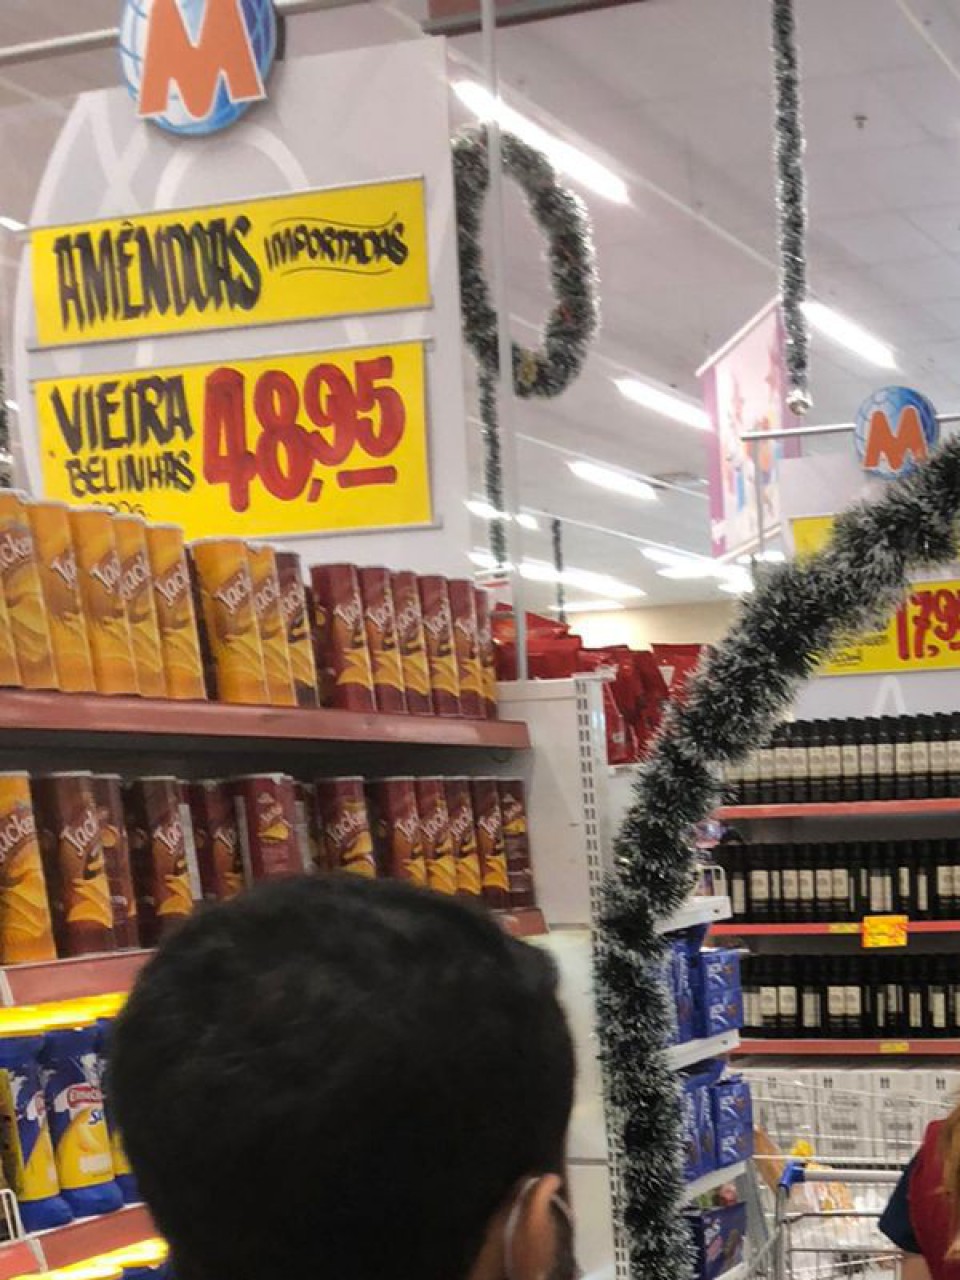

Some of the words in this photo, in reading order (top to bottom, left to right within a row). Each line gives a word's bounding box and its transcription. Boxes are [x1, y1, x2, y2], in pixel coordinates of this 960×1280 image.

[53, 216, 261, 331] AMÊNDOAS
[263, 222, 409, 271] IMPORTADAS
[862, 406, 929, 471] M
